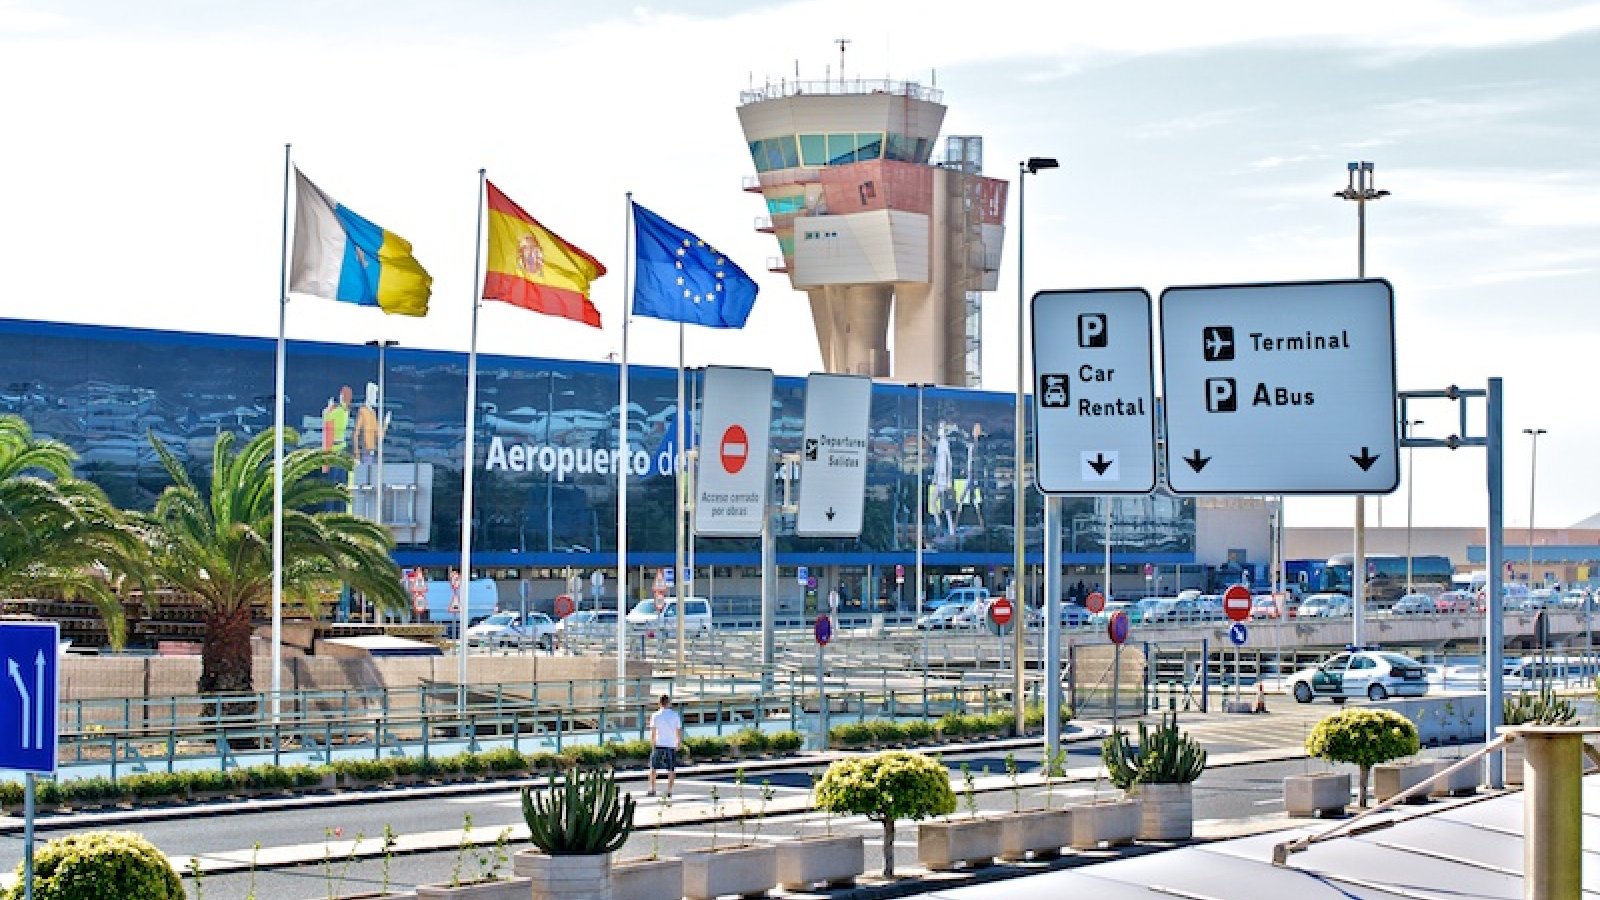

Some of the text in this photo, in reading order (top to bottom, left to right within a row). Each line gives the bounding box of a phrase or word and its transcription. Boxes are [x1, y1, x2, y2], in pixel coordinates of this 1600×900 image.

[1081, 315, 1104, 346] P
[1249, 329, 1350, 351] Terminal
[1079, 364, 1115, 383] Car
[1208, 379, 1233, 411] P
[1079, 397, 1145, 416] Rental
[820, 434, 866, 448] Departures
[485, 436, 651, 482] Aeropuerto
[828, 454, 859, 468] Salidas
